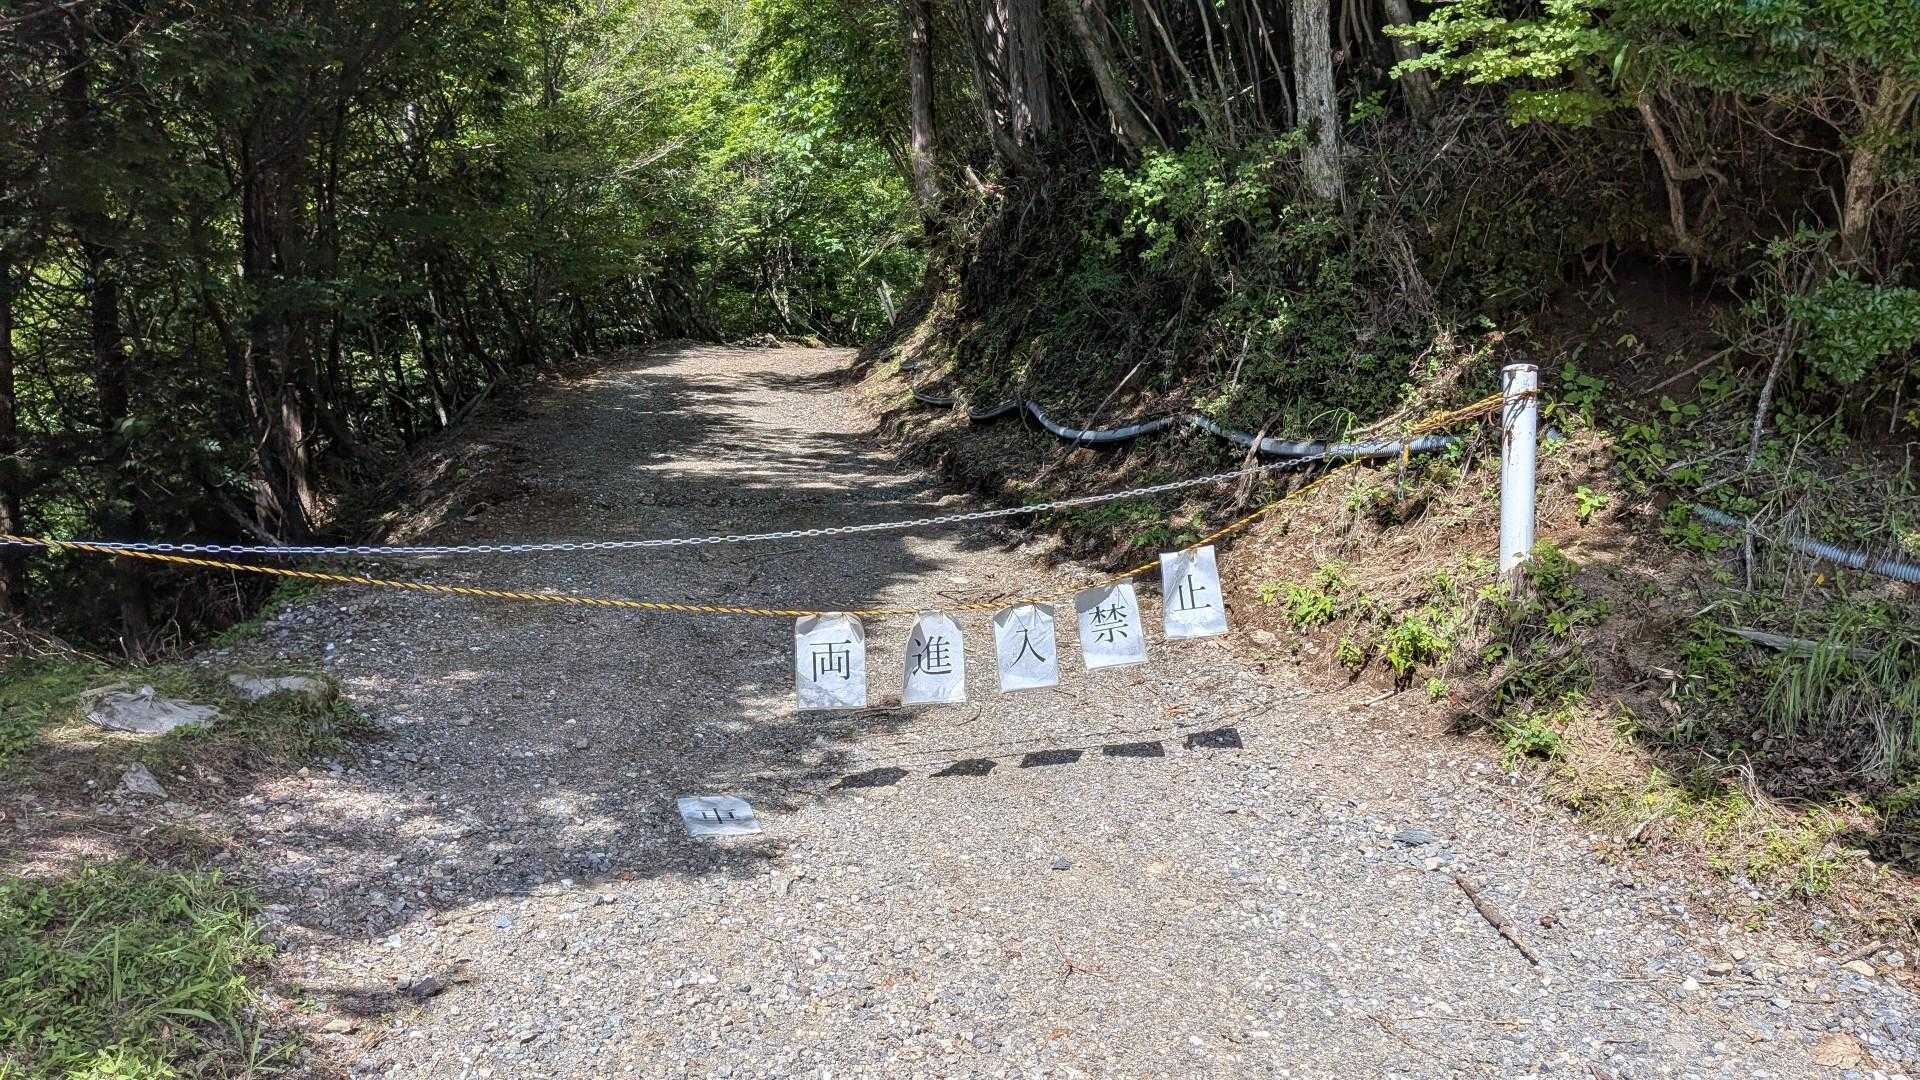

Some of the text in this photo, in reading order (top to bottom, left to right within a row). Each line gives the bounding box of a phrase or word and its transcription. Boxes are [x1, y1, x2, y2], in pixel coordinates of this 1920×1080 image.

[809, 574, 1211, 683] 両 進 入 禁 止
